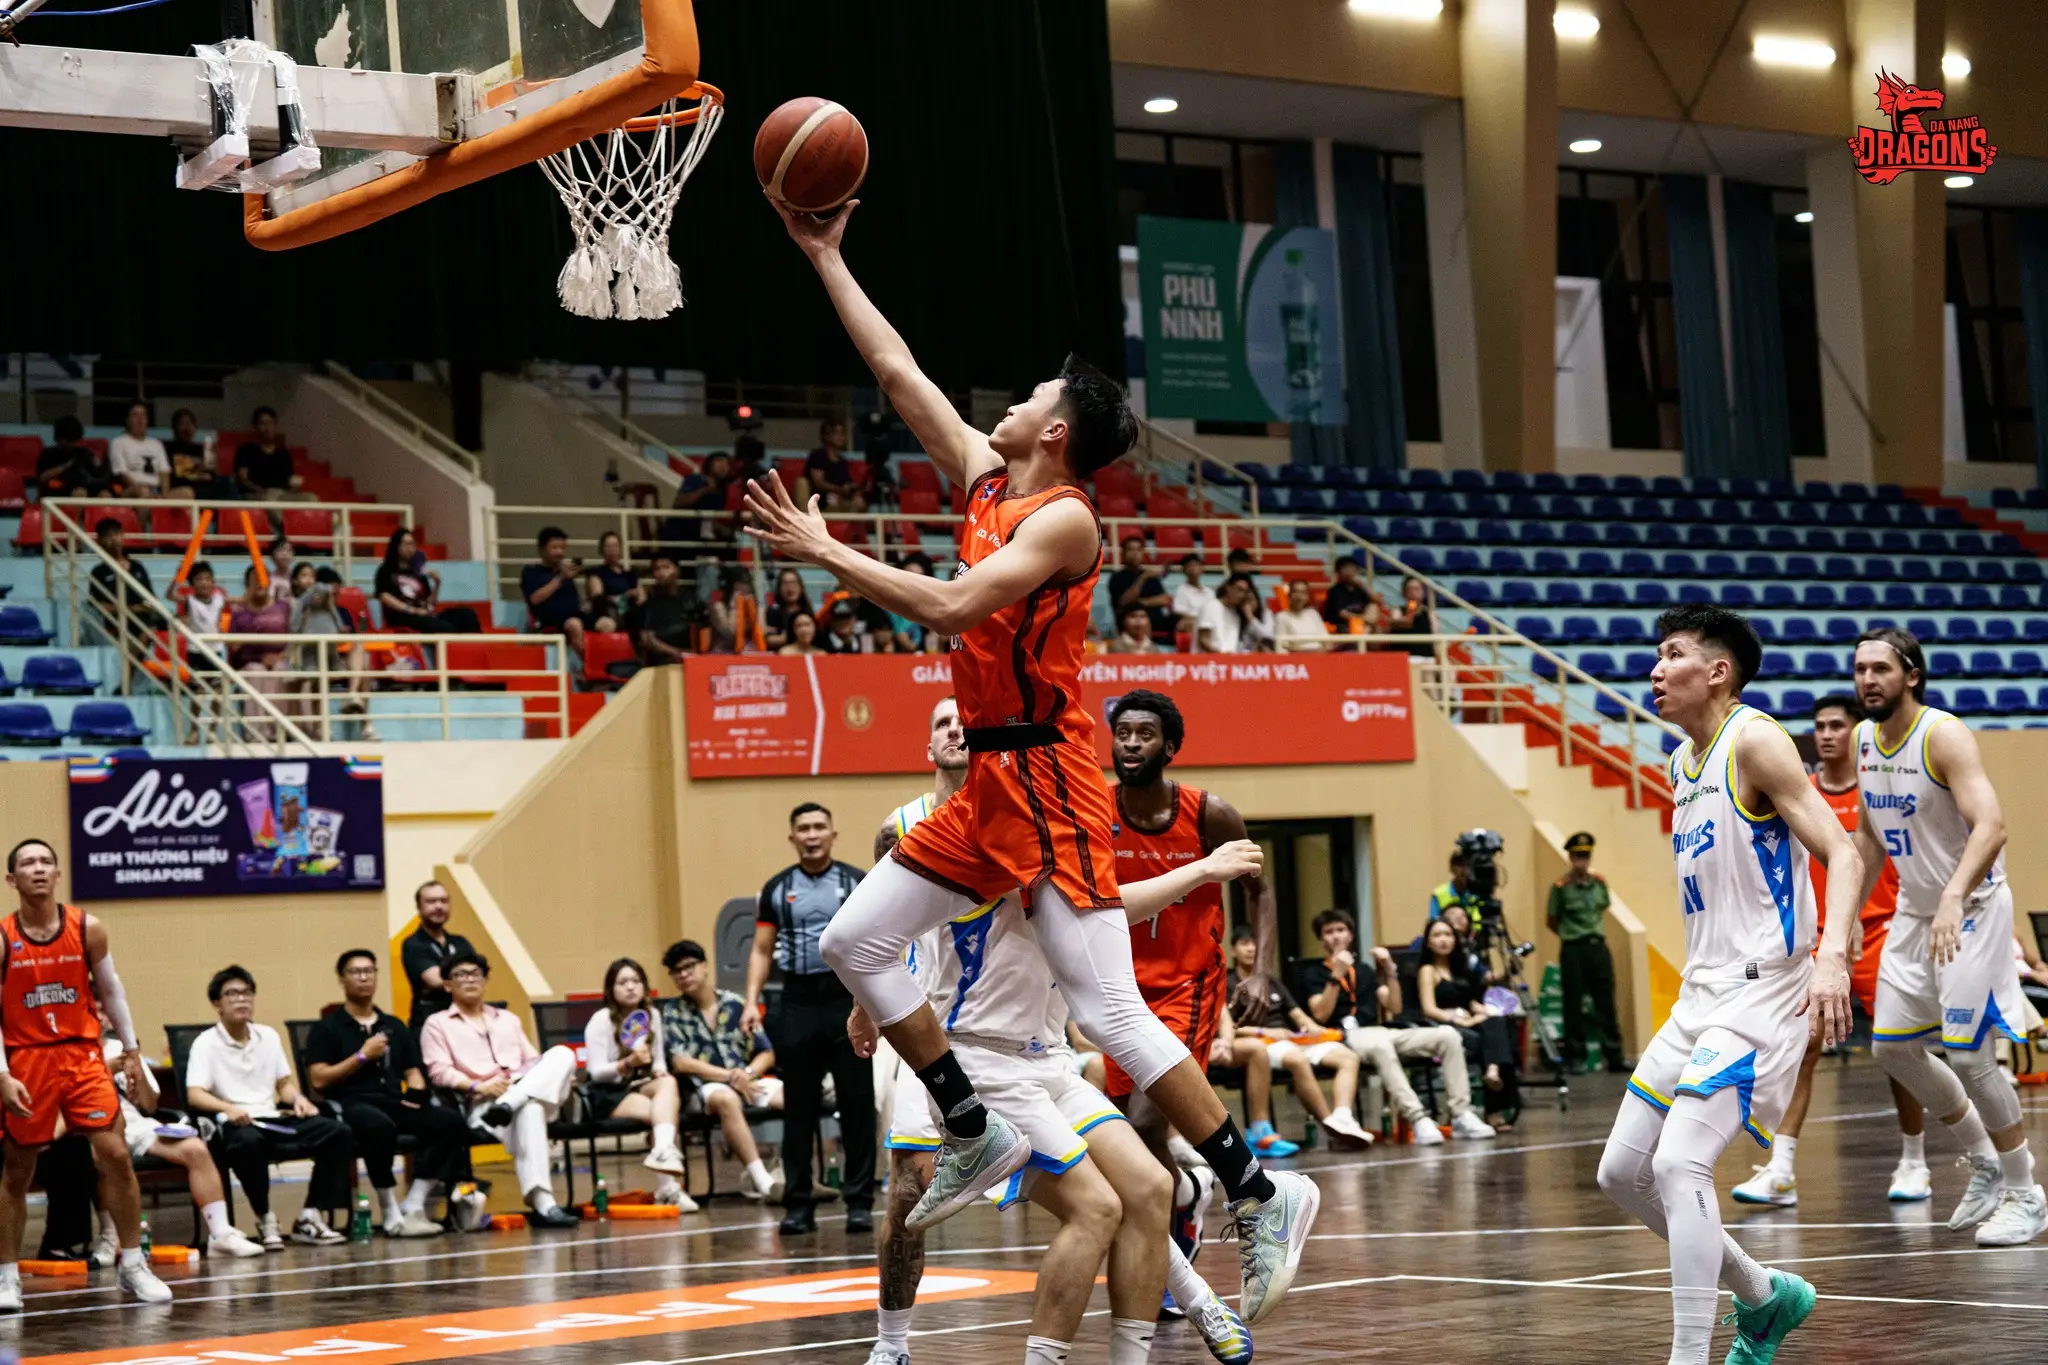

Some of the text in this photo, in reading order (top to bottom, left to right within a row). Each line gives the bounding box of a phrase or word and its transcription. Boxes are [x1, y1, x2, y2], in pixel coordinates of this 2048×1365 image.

[1161, 307, 1224, 341] NINH
[1078, 661, 1118, 681] YÊN
[1122, 660, 1187, 686] NGHIỆP
[1189, 660, 1228, 685] VIỆT
[1231, 664, 1270, 681] NAM
[1273, 664, 1310, 681] VBA
[83, 768, 229, 837] Aice
[1884, 828, 1912, 857] 51
[88, 852, 123, 867] KEM
[115, 867, 204, 884] SINGAPORE
[422, 1301, 756, 1344] FPT
